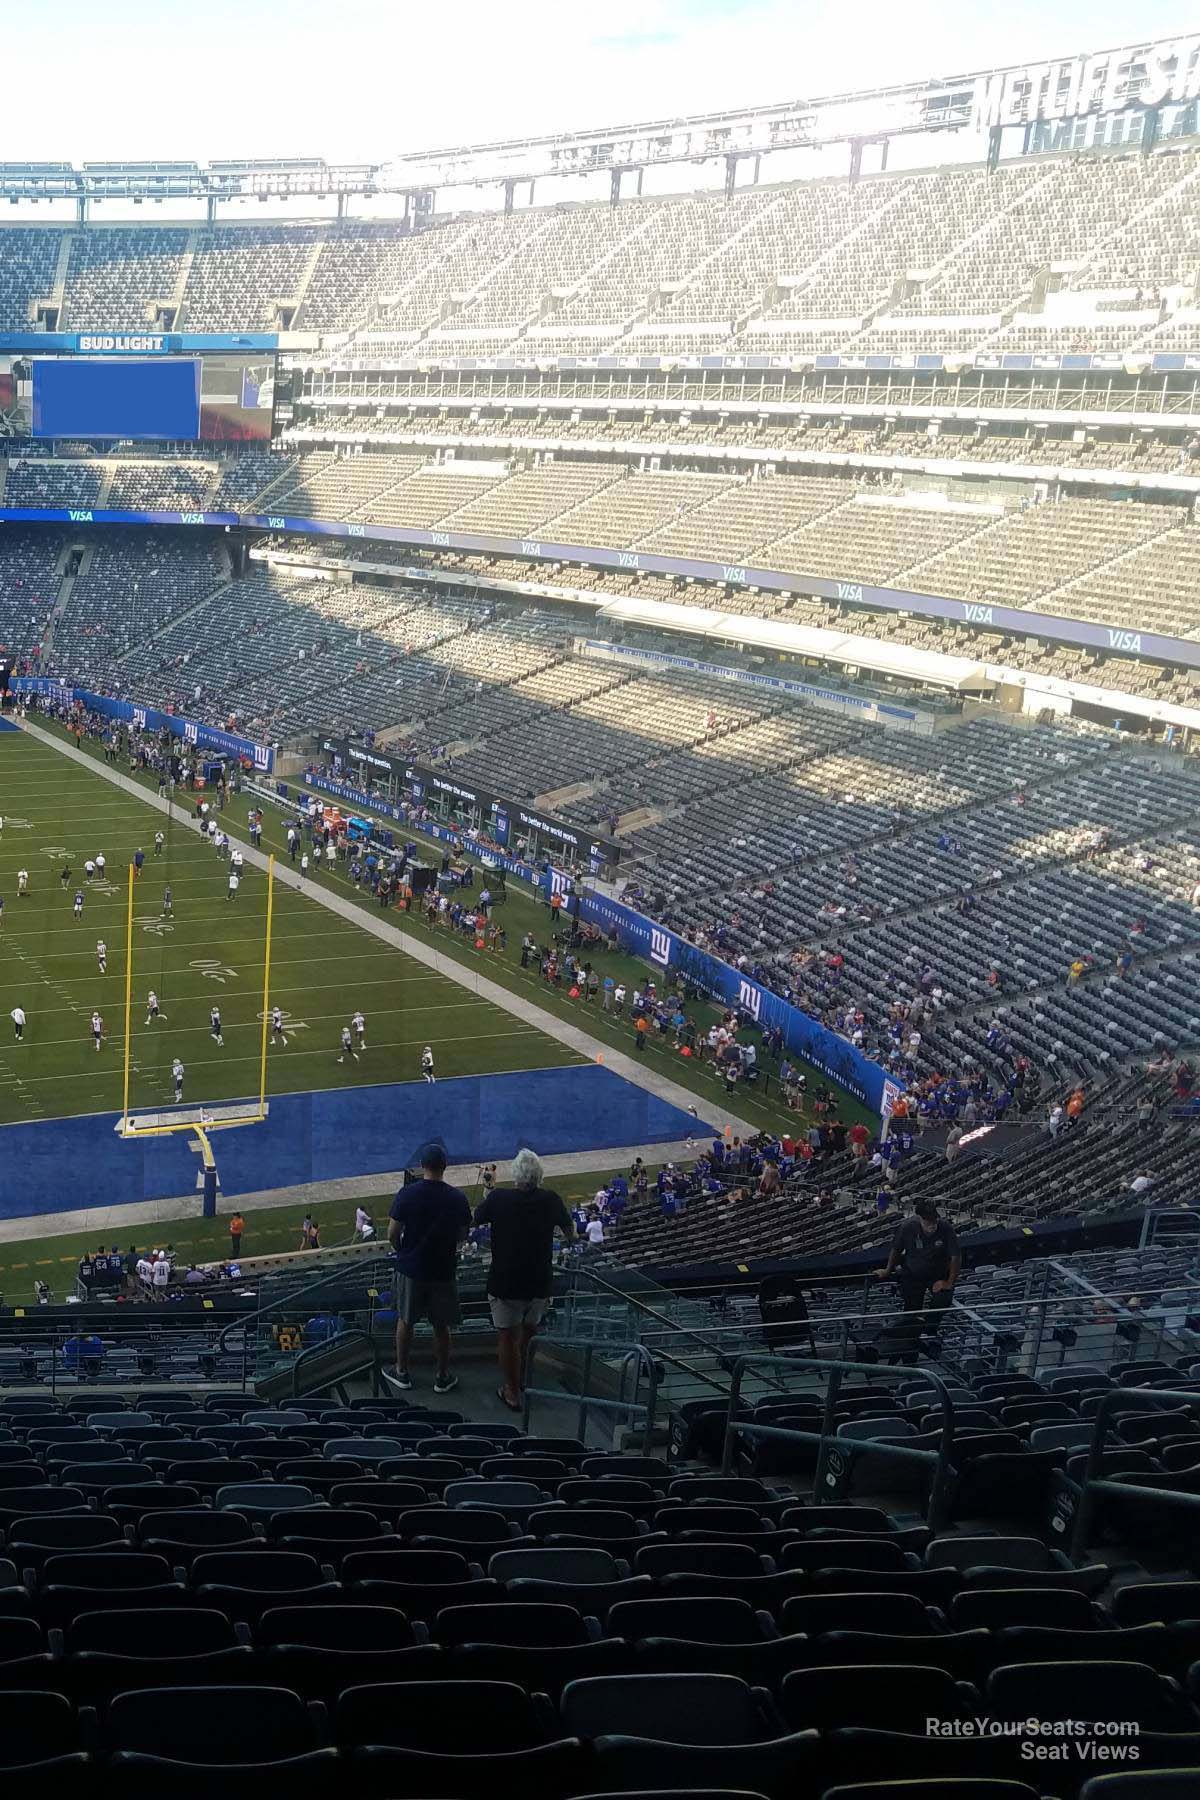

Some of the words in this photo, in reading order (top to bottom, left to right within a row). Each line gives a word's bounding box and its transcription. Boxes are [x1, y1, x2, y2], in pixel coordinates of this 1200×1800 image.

[80, 336, 114, 350] BUD
[116, 336, 164, 350] LIGHT
[68, 511, 93, 522] VISA
[179, 513, 205, 524] VISA
[268, 517, 285, 529] VISA
[348, 525, 365, 537] VISA
[432, 533, 450, 545] VISA
[522, 542, 540, 556] VISA
[618, 552, 639, 568] VISA
[722, 566, 746, 582] VISA
[836, 583, 863, 601] VISA
[962, 603, 993, 624] VISA
[1107, 629, 1142, 652] VISA
[185, 723, 198, 744] ny
[255, 745, 269, 770] ny
[355, 751, 367, 761] better
[433, 778, 441, 787] The
[441, 780, 453, 791] better
[317, 780, 329, 791] NEW
[329, 783, 341, 794] YORK
[343, 787, 367, 804] FOOTBALL
[369, 799, 388, 813] GIANTS
[520, 812, 528, 822] The
[528, 816, 541, 829] better
[542, 821, 550, 832] the
[550, 826, 563, 838] world
[563, 833, 578, 844] works.
[475, 845, 501, 864] FOOTBALL
[504, 859, 525, 877] GIANTS
[131, 916, 175, 934] 30
[601, 905, 630, 928] FOOTBALL
[630, 920, 650, 940] GIANTS
[651, 928, 670, 966] ny
[189, 959, 239, 977] 20
[740, 981, 761, 1021] ny
[824, 1065, 847, 1088] FOOTBALL
[848, 1080, 866, 1100] GIANTS
